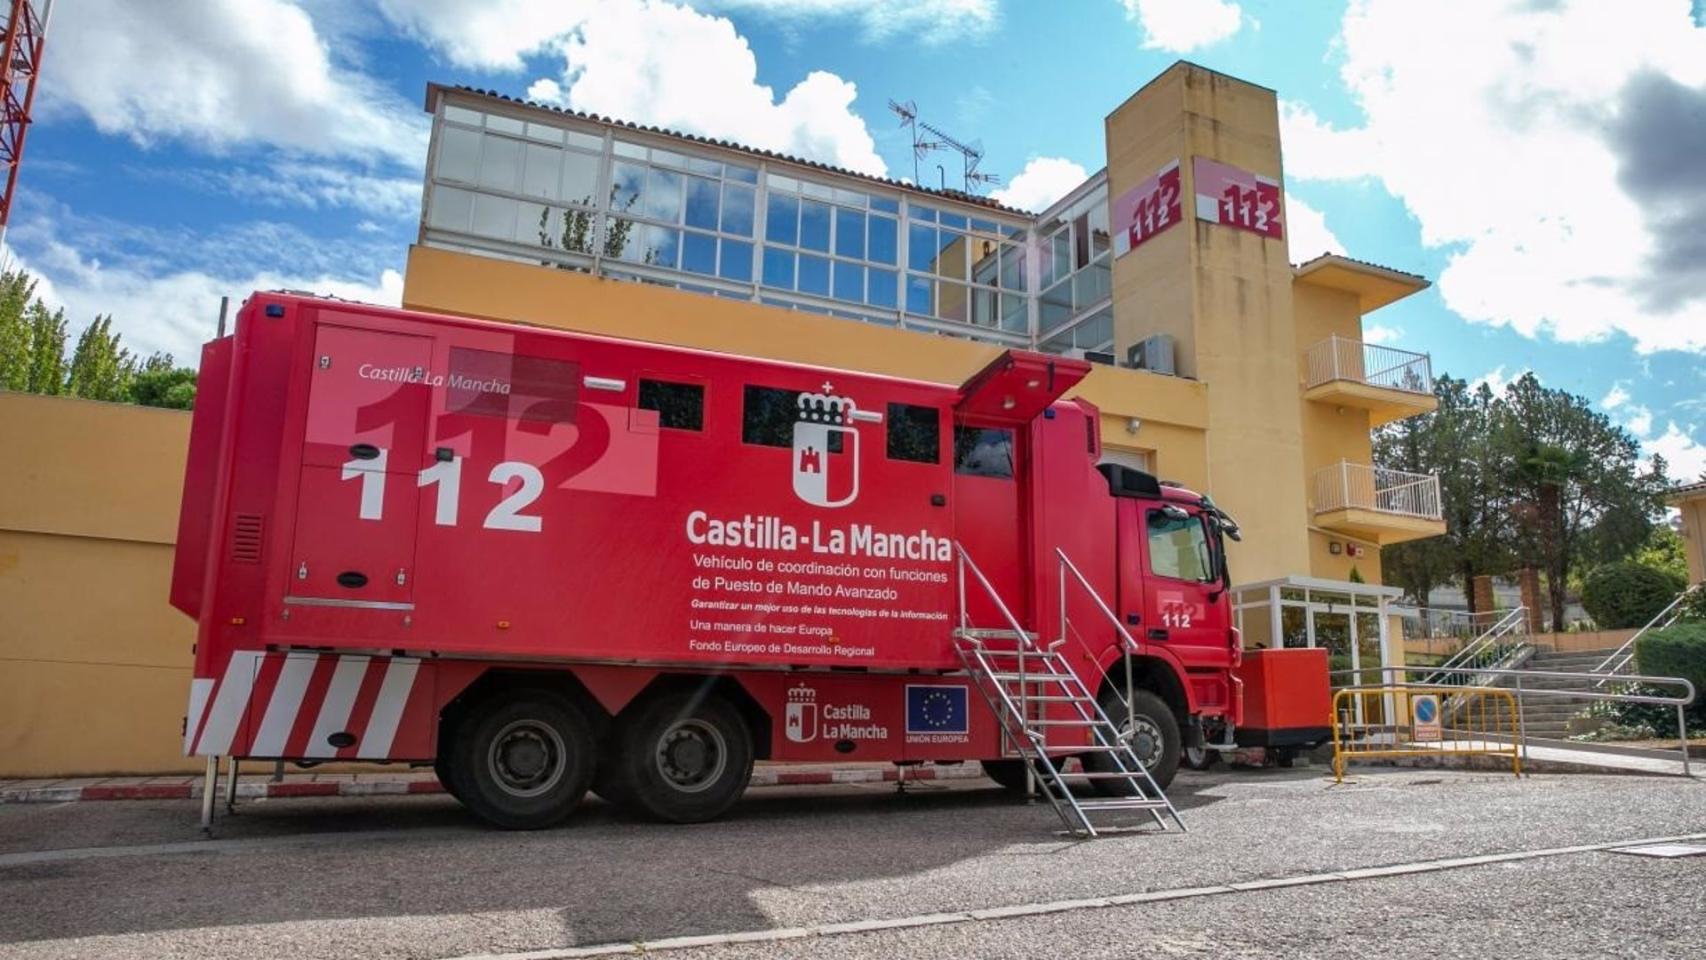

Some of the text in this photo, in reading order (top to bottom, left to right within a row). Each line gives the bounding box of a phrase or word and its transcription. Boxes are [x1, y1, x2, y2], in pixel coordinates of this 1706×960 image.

[1133, 204, 1169, 240] 112
[1224, 201, 1269, 231] 112
[448, 374, 511, 395] Mancha
[342, 448, 545, 533] 112
[850, 523, 952, 561] Mancha
[693, 553, 948, 583] Vehículo de coordinación con funciones
[692, 576, 898, 601] de Puesto de Mando Avanzado
[691, 598, 739, 611] Garantizar
[741, 602, 753, 611] un
[755, 603, 781, 615] mejor
[782, 605, 799, 613] uso
[801, 605, 812, 614] de
[813, 605, 827, 615] las
[879, 608, 890, 618] de
[891, 609, 899, 619] la
[690, 619, 833, 638] Una manera de hacer Europa
[1162, 613, 1191, 628] 112
[689, 639, 875, 658] Fondo Europeo de Desarrollo Regional
[823, 704, 871, 720] Castilla
[823, 724, 888, 740] La Mancha
[906, 733, 969, 744] UNIÓN EUROPEA
